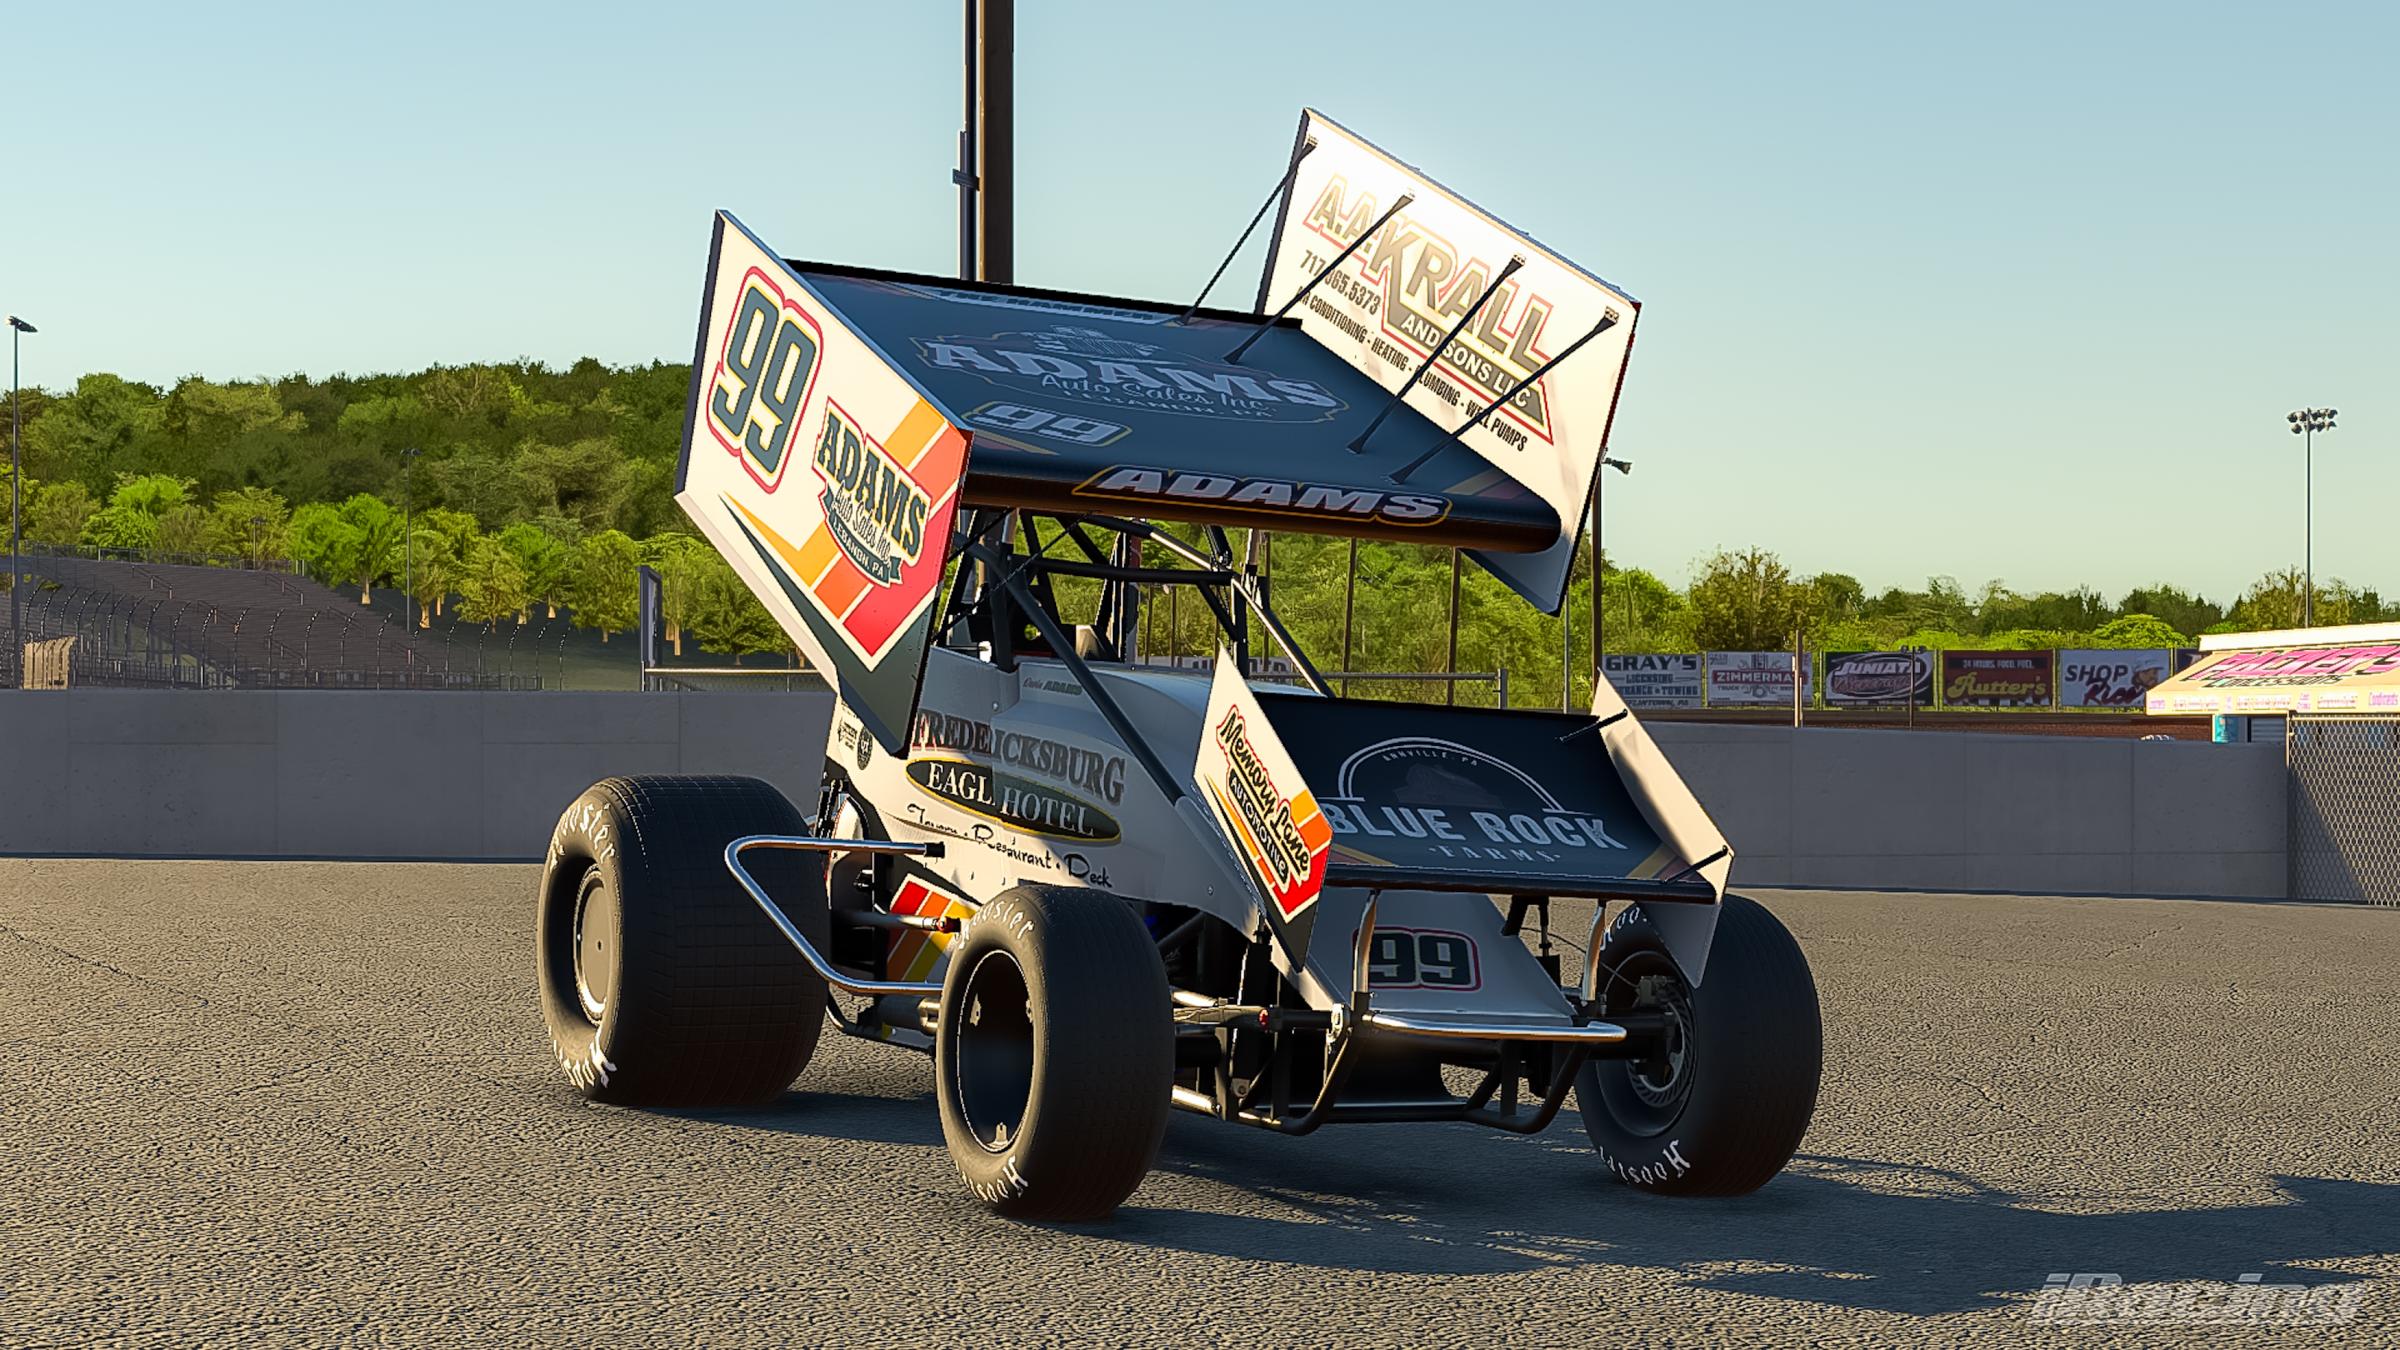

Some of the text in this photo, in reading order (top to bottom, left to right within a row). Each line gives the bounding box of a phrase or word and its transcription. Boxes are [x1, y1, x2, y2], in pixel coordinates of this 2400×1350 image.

[1300, 250, 1382, 316] 717365.5373
[1369, 219, 1542, 375] KRALL
[925, 341, 1338, 408] ADAMS
[1309, 294, 1369, 344] CONDITIONING
[1370, 337, 1409, 372] HEATING
[1416, 366, 1461, 408] LUMBING
[1490, 417, 1529, 452] PUMPS
[1401, 314, 1441, 348] AND
[1441, 340, 1493, 384] SONS
[711, 286, 817, 475] 99
[1042, 374, 1112, 395] Auto
[1122, 383, 1214, 406] Sales
[973, 403, 1123, 444] 99
[818, 408, 926, 559] ADAMS
[1098, 469, 1444, 519] ADAMS
[1605, 656, 1697, 671] GRAY'S
[1717, 672, 1795, 682] ZIMMERMA
[1834, 662, 1921, 675] JUNIATA
[1947, 672, 2047, 699] Rutter's
[2064, 664, 2129, 682] SHOP
[912, 710, 1127, 808] FREDEICKSBURG
[926, 762, 998, 807] EAGL
[1000, 786, 1094, 838] HOTEL
[1219, 712, 1276, 818] Memory
[1269, 805, 1310, 872] Lane
[1230, 776, 1287, 877] AUTOMOTIVE
[1318, 802, 1628, 850] BLUE ROCK
[971, 824, 1052, 869] Resaurant
[1063, 853, 1113, 888] Deck
[1368, 931, 1472, 986] 99
